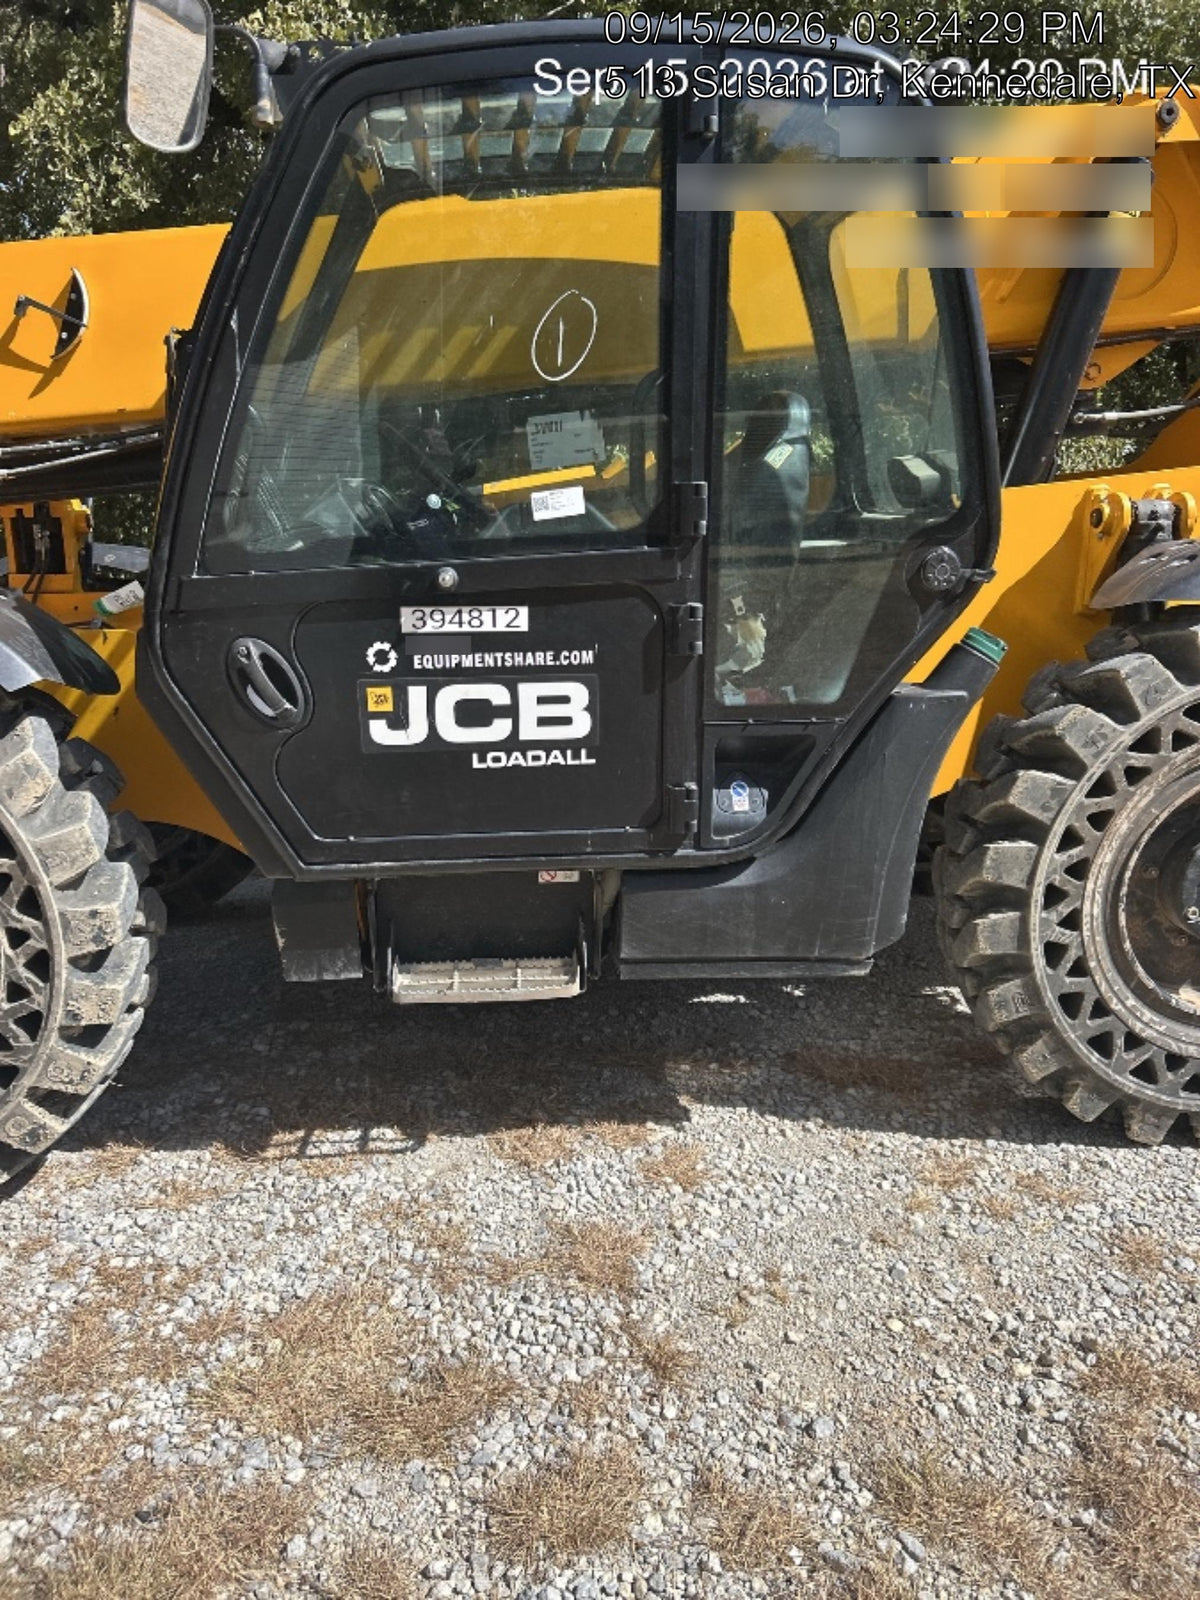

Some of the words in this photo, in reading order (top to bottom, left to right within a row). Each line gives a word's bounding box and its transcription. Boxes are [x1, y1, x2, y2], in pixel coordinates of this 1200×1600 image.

[411, 607, 522, 630] 394812
[413, 650, 595, 670] EQUIPMENTSHARE.COM
[368, 681, 593, 746] JCB
[471, 748, 597, 769] LOADALL
